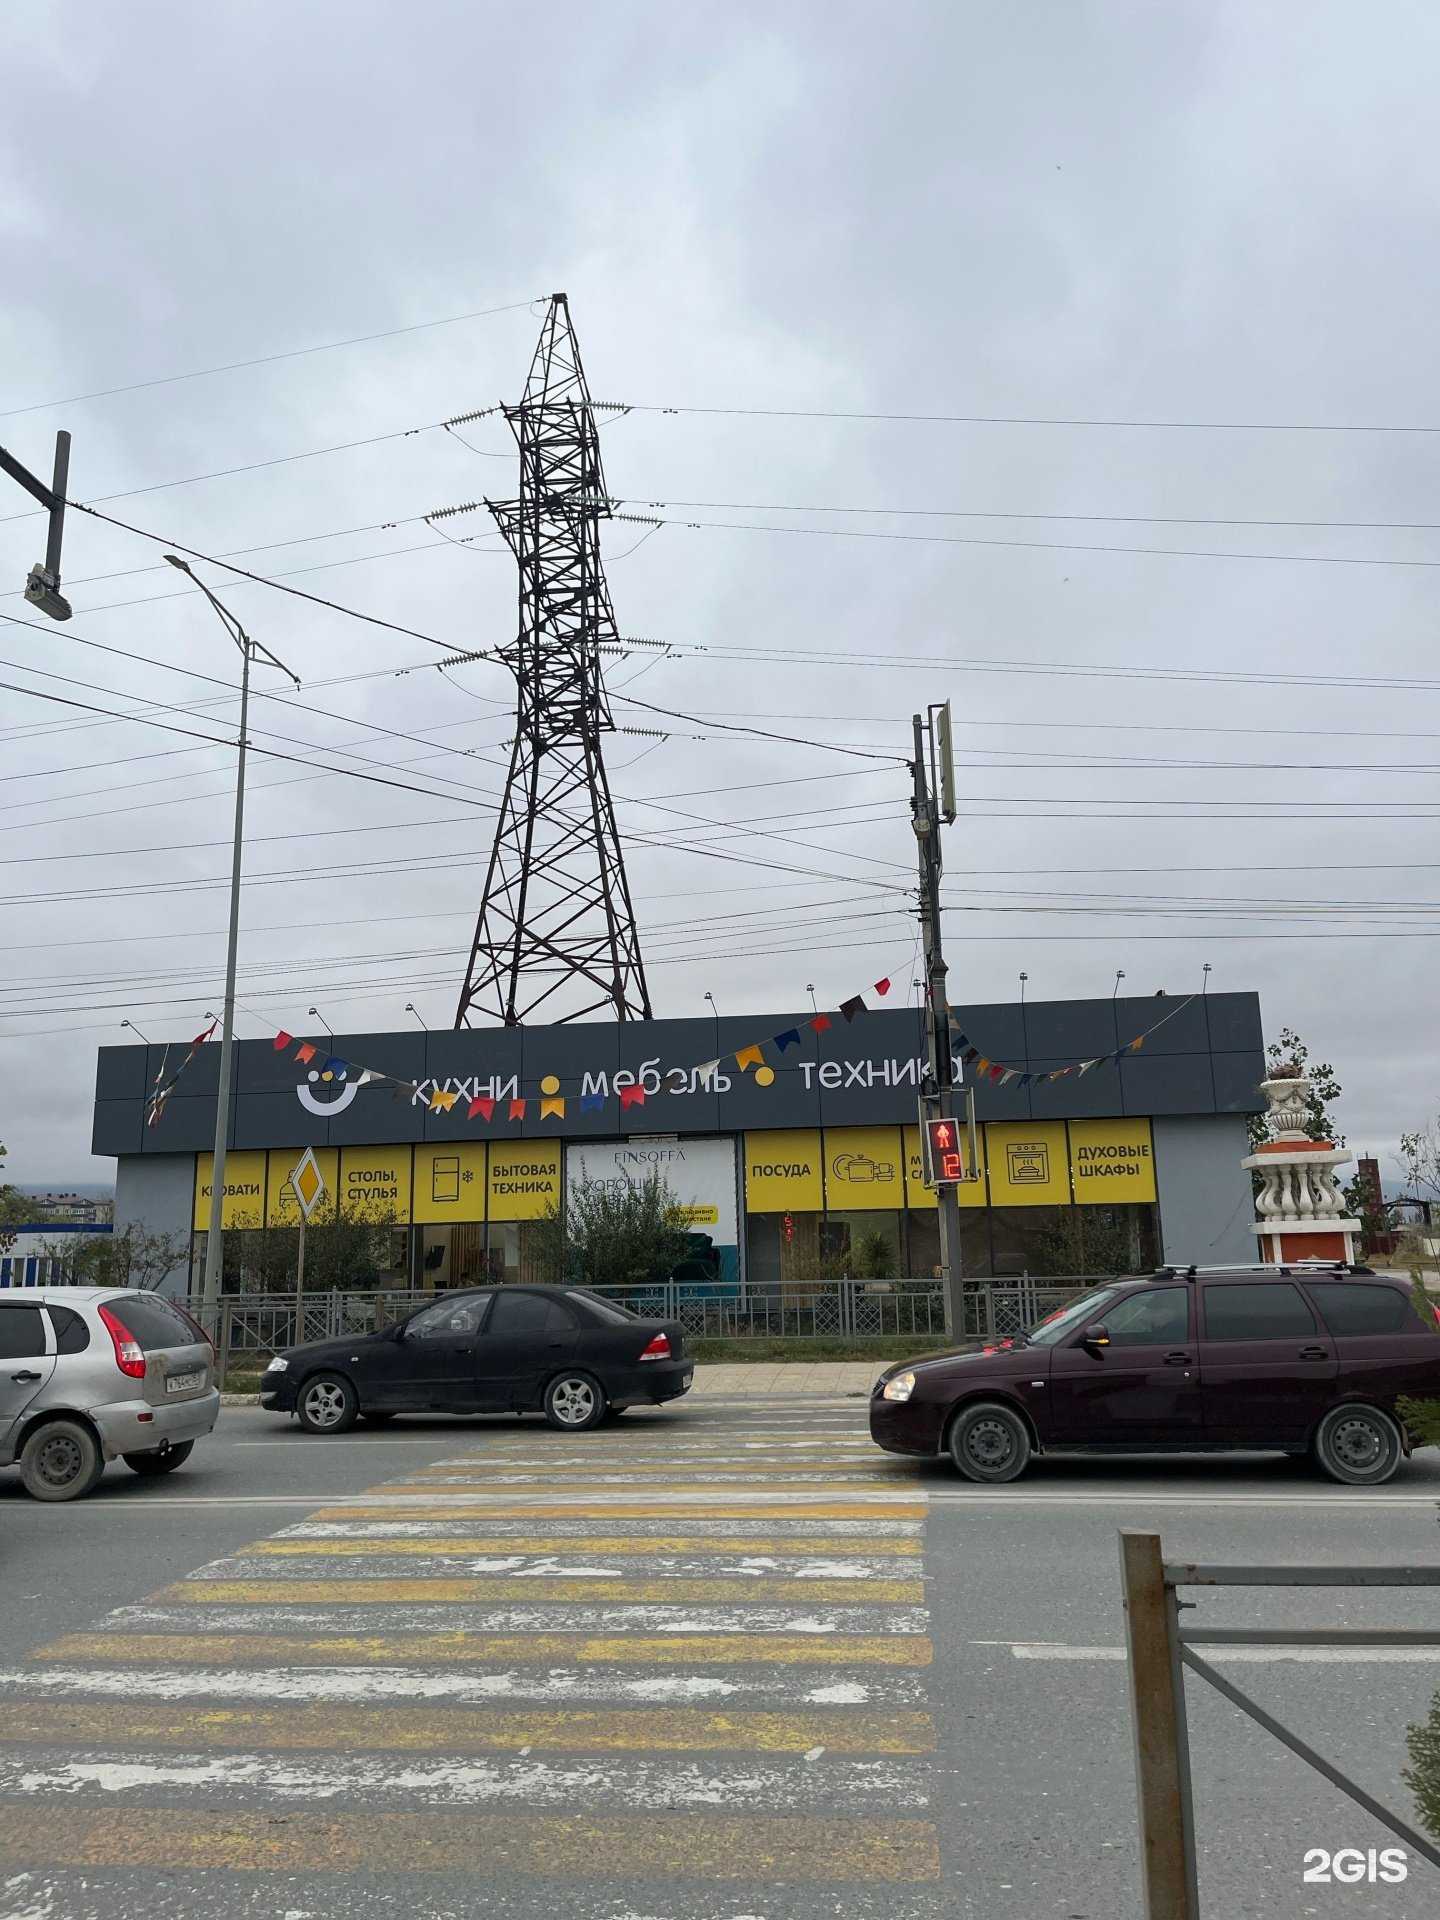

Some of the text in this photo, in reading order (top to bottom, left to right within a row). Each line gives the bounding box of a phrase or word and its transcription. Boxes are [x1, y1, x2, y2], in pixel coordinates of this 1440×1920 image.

[411, 1055, 965, 1114] кухни мебель техника
[1078, 1145, 1149, 1160] ДУХОВЫЕ
[493, 1163, 556, 1177] БЫТОВАЯ
[752, 1163, 811, 1177] ПОСУДА
[1080, 1163, 1140, 1176] ШКАФЫ
[348, 1170, 397, 1184] СТОЛЫ,
[348, 1186, 397, 1200] СТУЛЬЯ
[492, 1181, 553, 1195] ТЕХНИКА
